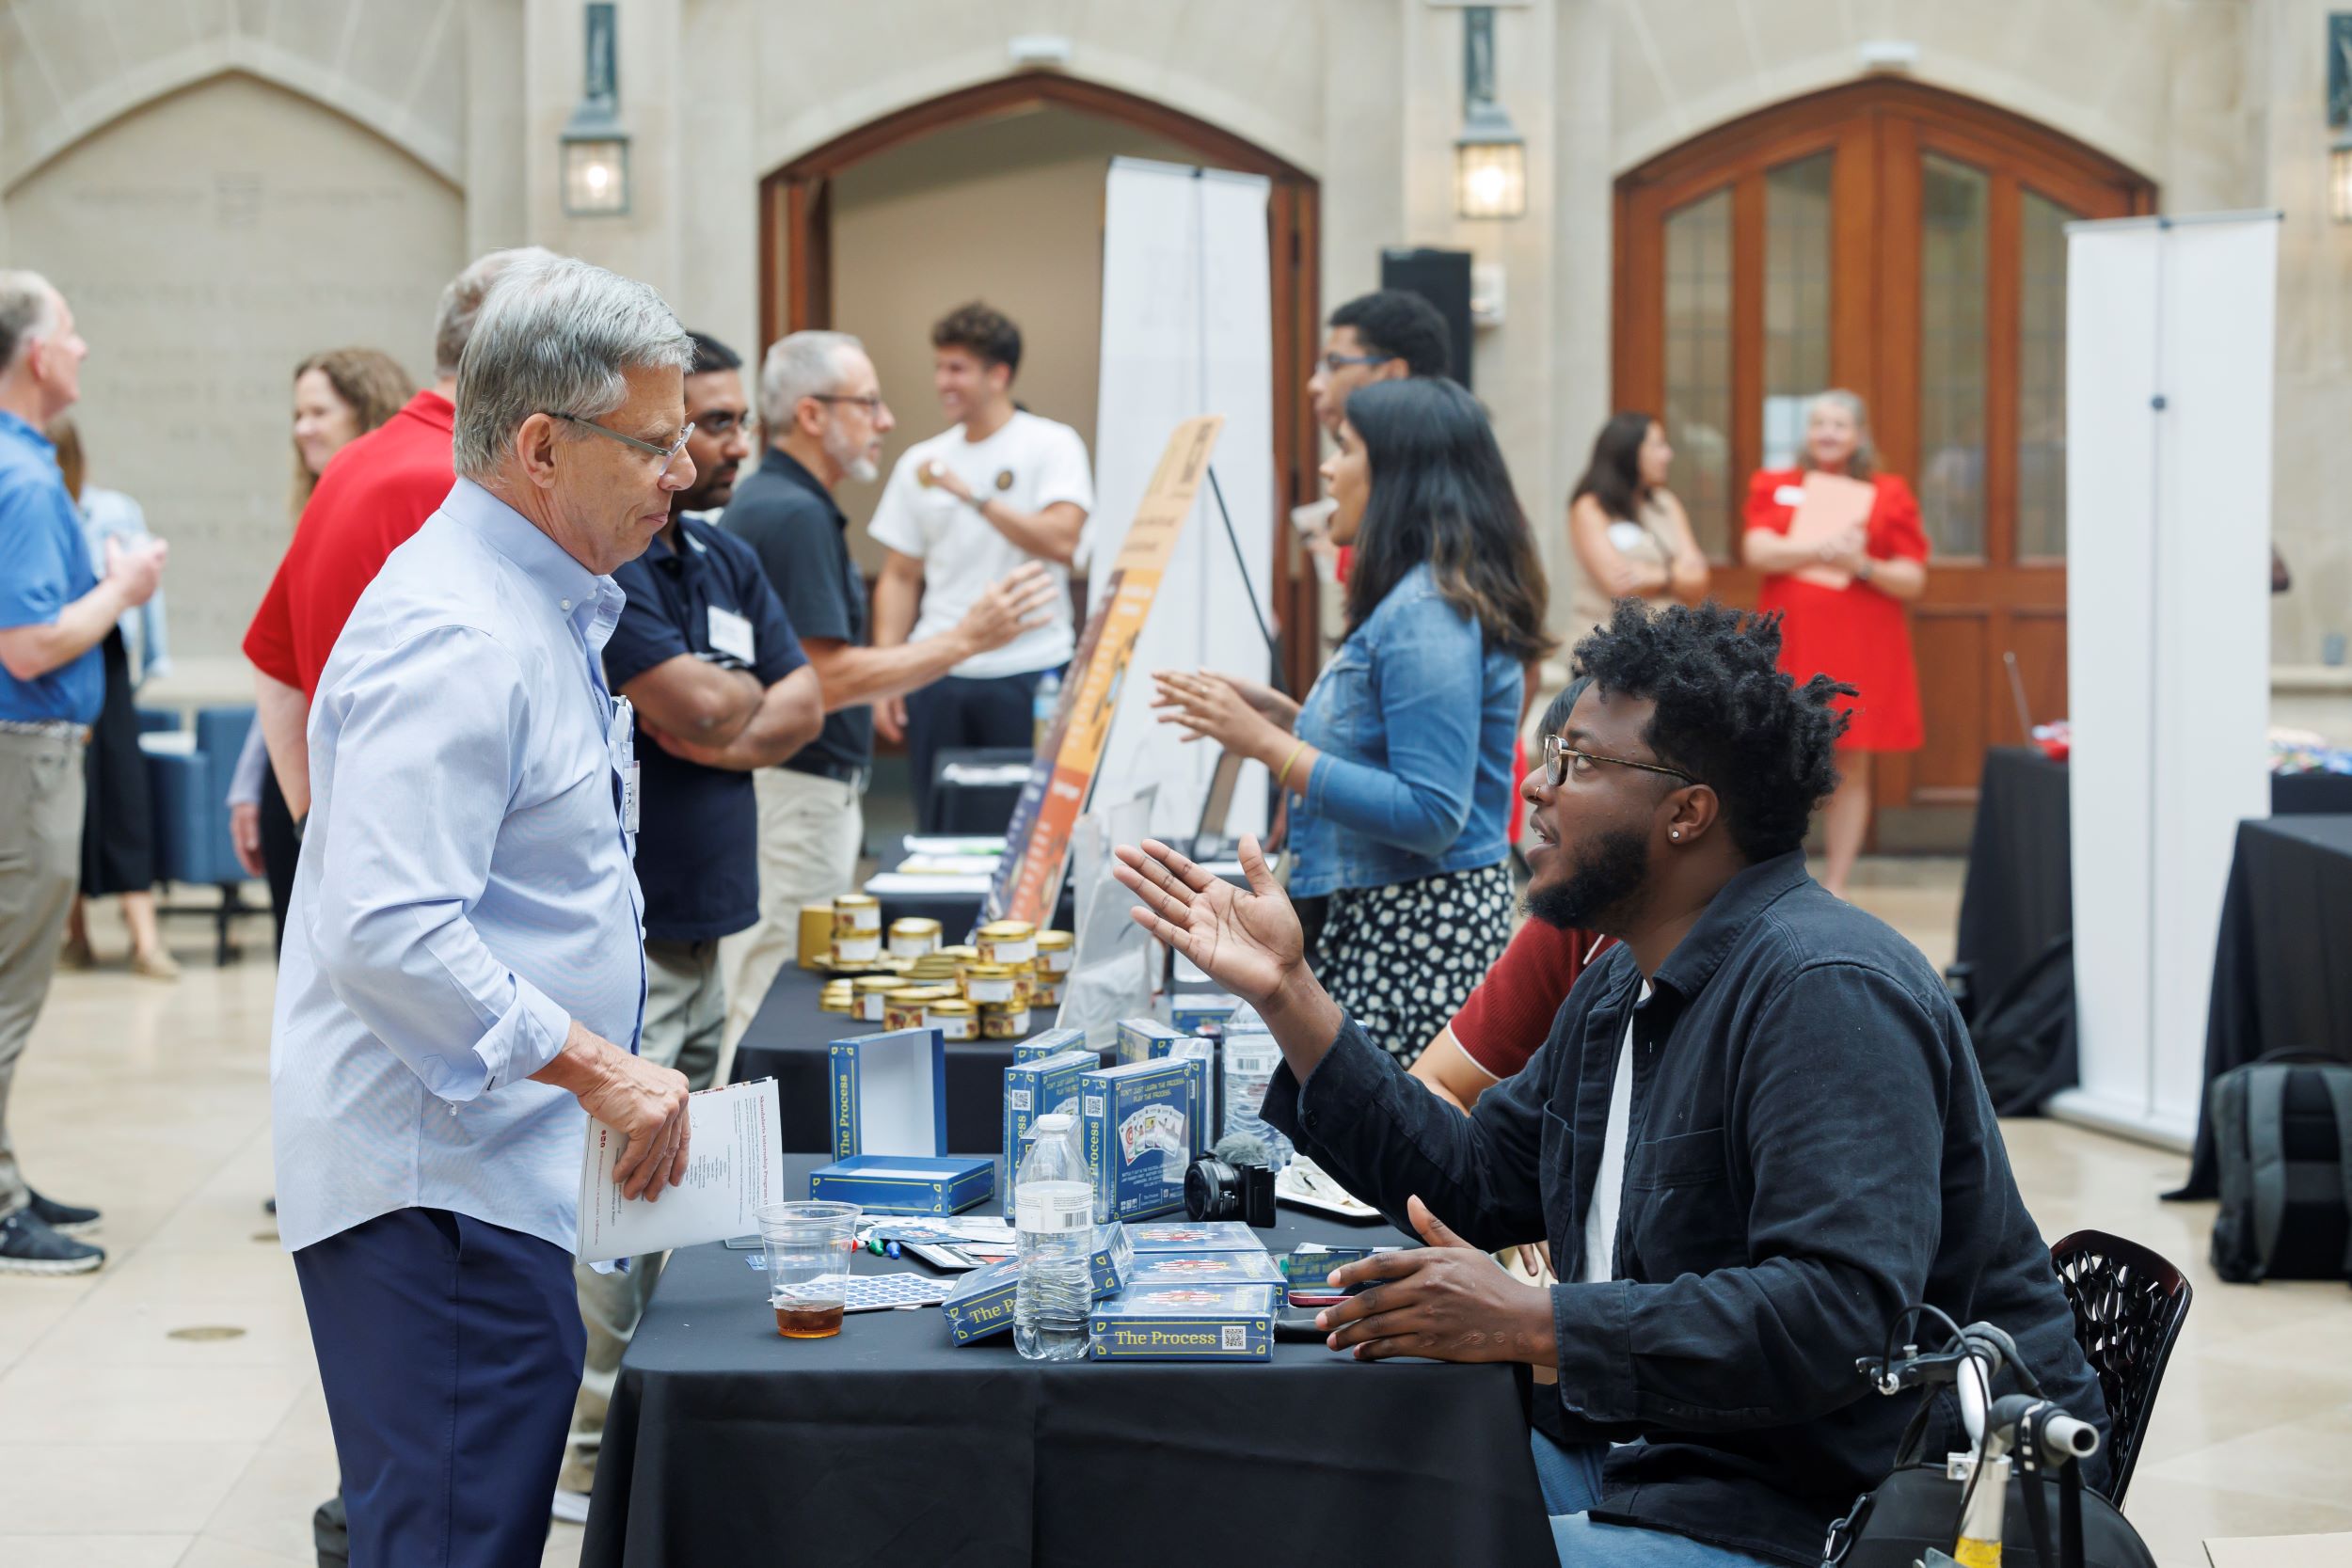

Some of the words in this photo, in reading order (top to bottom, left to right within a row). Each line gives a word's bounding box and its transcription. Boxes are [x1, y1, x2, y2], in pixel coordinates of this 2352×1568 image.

[839, 1074, 850, 1127] Process
[840, 1130, 850, 1157] The
[1089, 1121, 1099, 1177] Process
[969, 1306, 1001, 1324] The
[1114, 1330, 1147, 1345] The
[1151, 1331, 1216, 1345] Process
